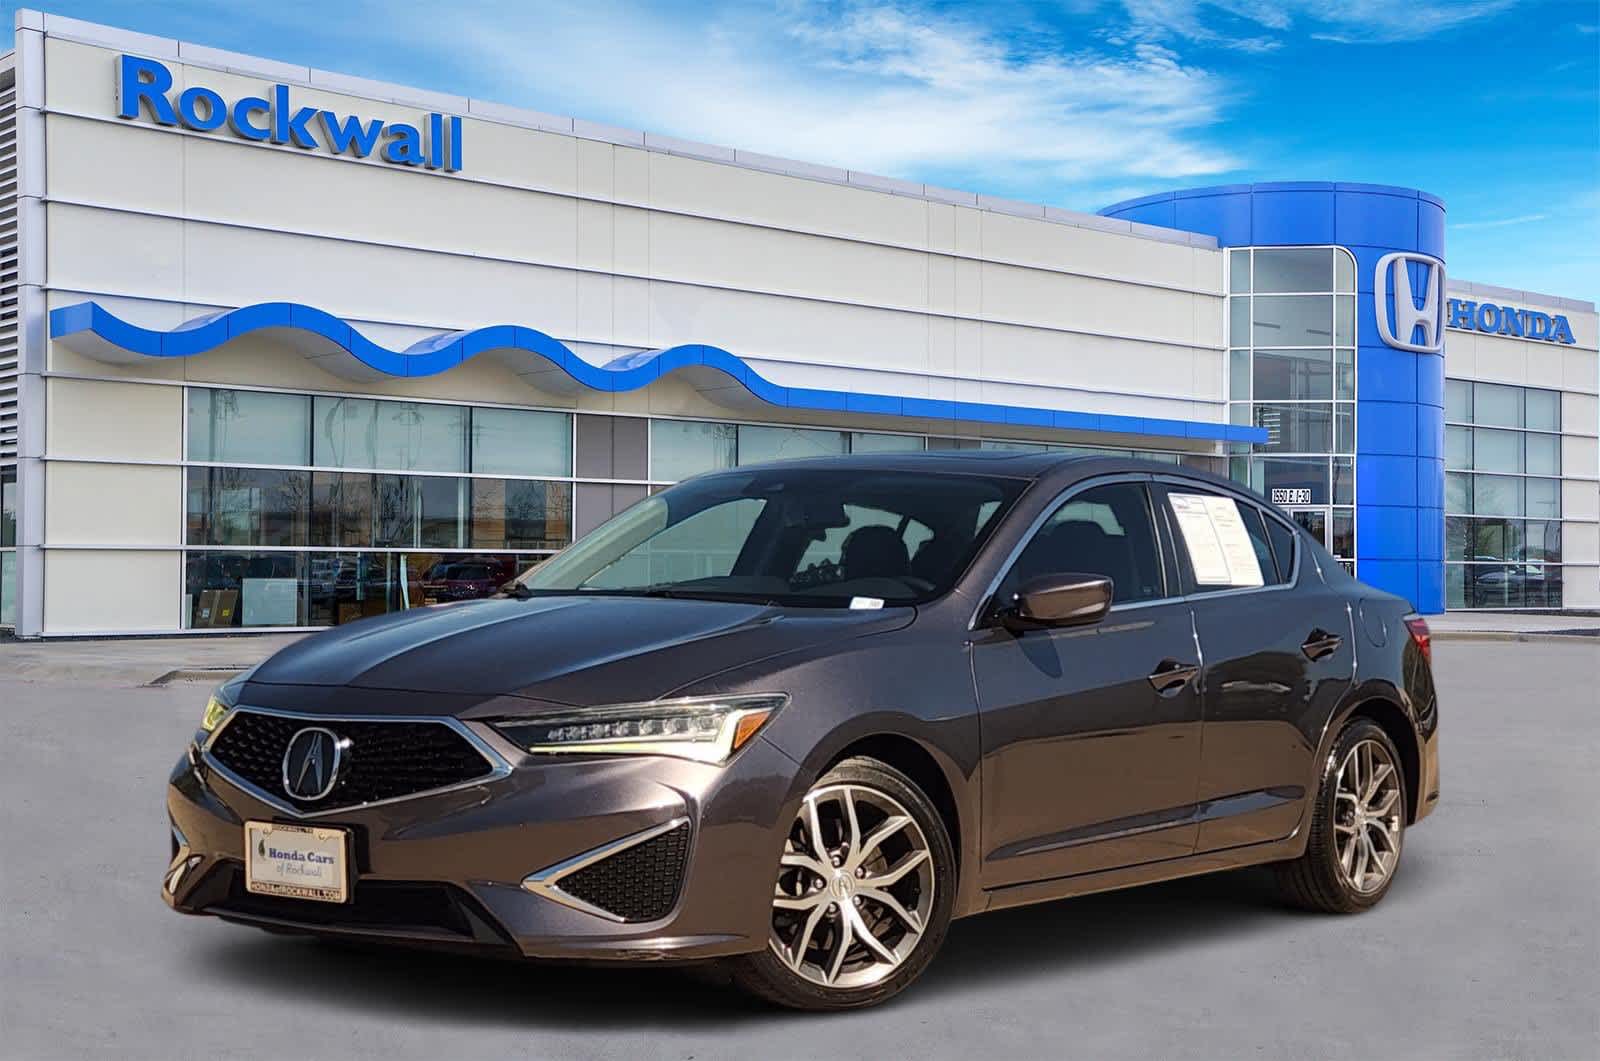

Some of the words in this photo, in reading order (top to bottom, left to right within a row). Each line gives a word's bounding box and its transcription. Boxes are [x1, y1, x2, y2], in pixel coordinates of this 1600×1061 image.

[117, 54, 463, 173] Rockwall
[1448, 298, 1577, 344] HONDA
[268, 847, 306, 862] Honda
[307, 852, 335, 865] Cars
